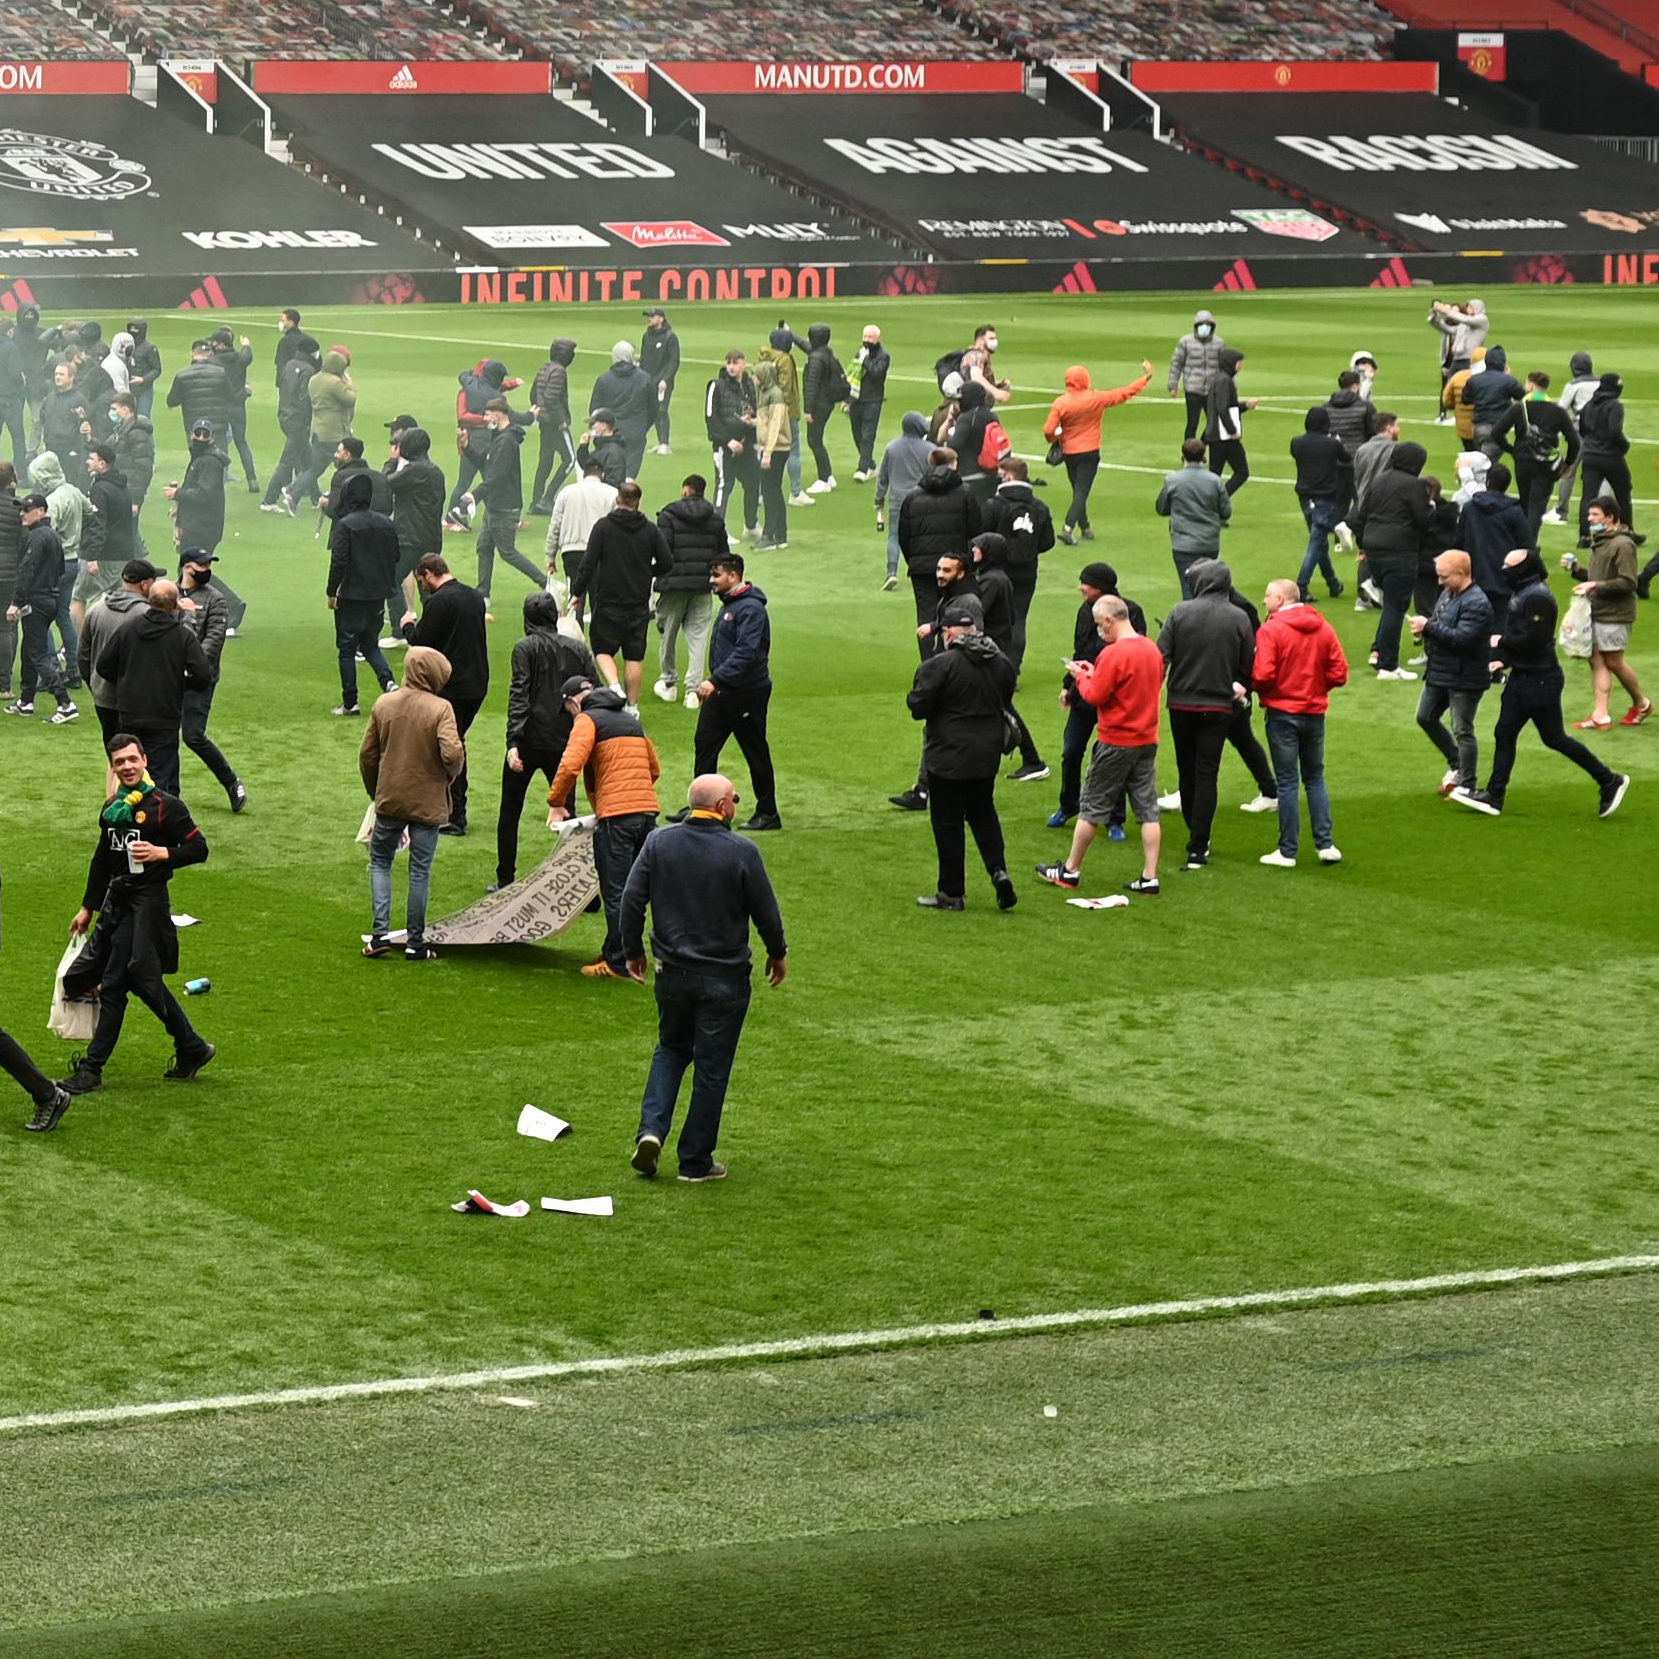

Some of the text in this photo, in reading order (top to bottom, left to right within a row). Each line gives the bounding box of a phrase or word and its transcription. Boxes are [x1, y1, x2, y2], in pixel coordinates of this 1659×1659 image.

[754, 64, 925, 89] MANUTD.COM
[371, 143, 676, 179] UNITED
[823, 138, 1149, 173] AGAINST
[1275, 135, 1579, 171] RACISM
[31, 180, 135, 194] UNITED
[182, 230, 379, 249] KOHLER
[460, 267, 835, 303] INFINITE CONTROL
